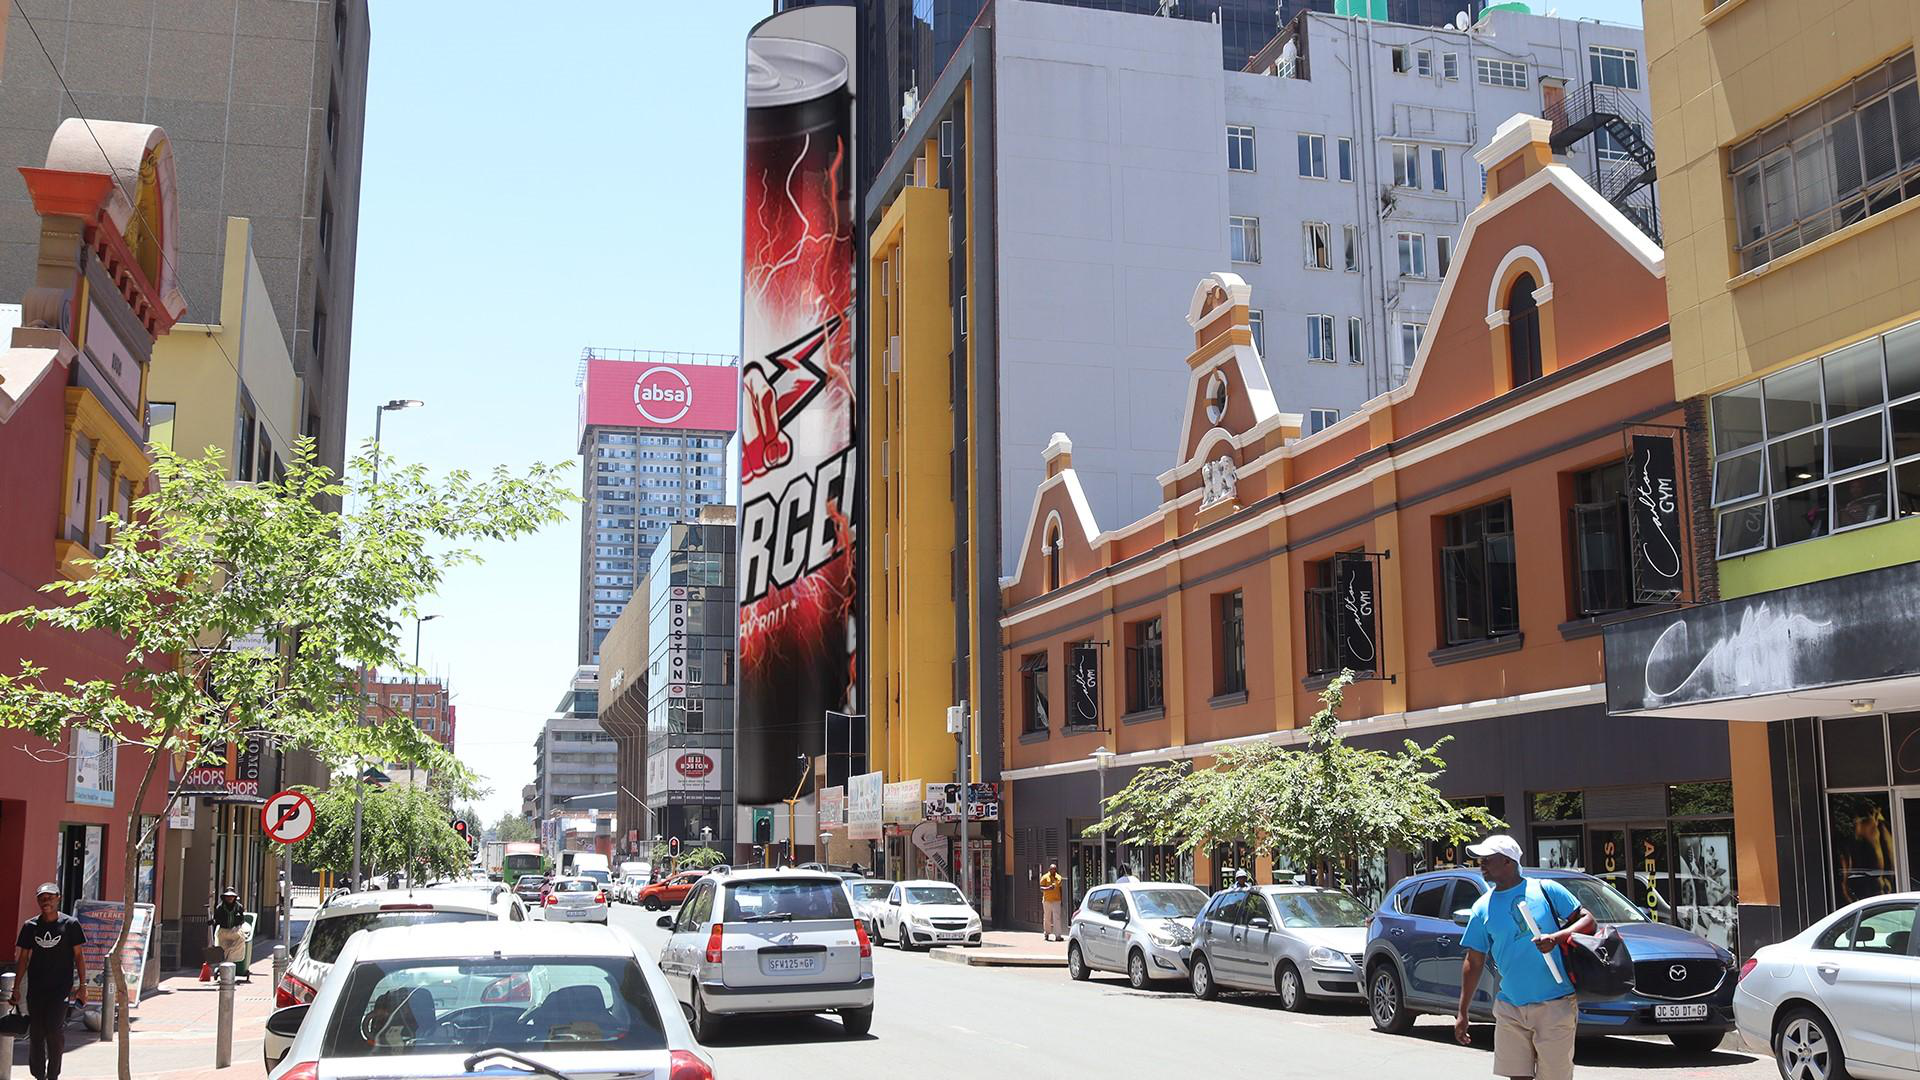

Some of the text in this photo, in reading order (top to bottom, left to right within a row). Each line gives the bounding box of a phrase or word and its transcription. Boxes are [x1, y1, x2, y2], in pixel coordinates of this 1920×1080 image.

[642, 383, 685, 402] absa
[1658, 478, 1675, 513] GYM
[1360, 591, 1372, 616] GYM
[673, 604, 684, 680] BOSTON
[1087, 669, 1096, 687] GYM
[187, 770, 225, 785] SHOPS
[226, 782, 258, 795] SHOPS
[277, 804, 300, 831] P
[804, 958, 814, 968] GP
[1657, 1006, 1667, 1017] JC
[1697, 1005, 1706, 1016] GP
